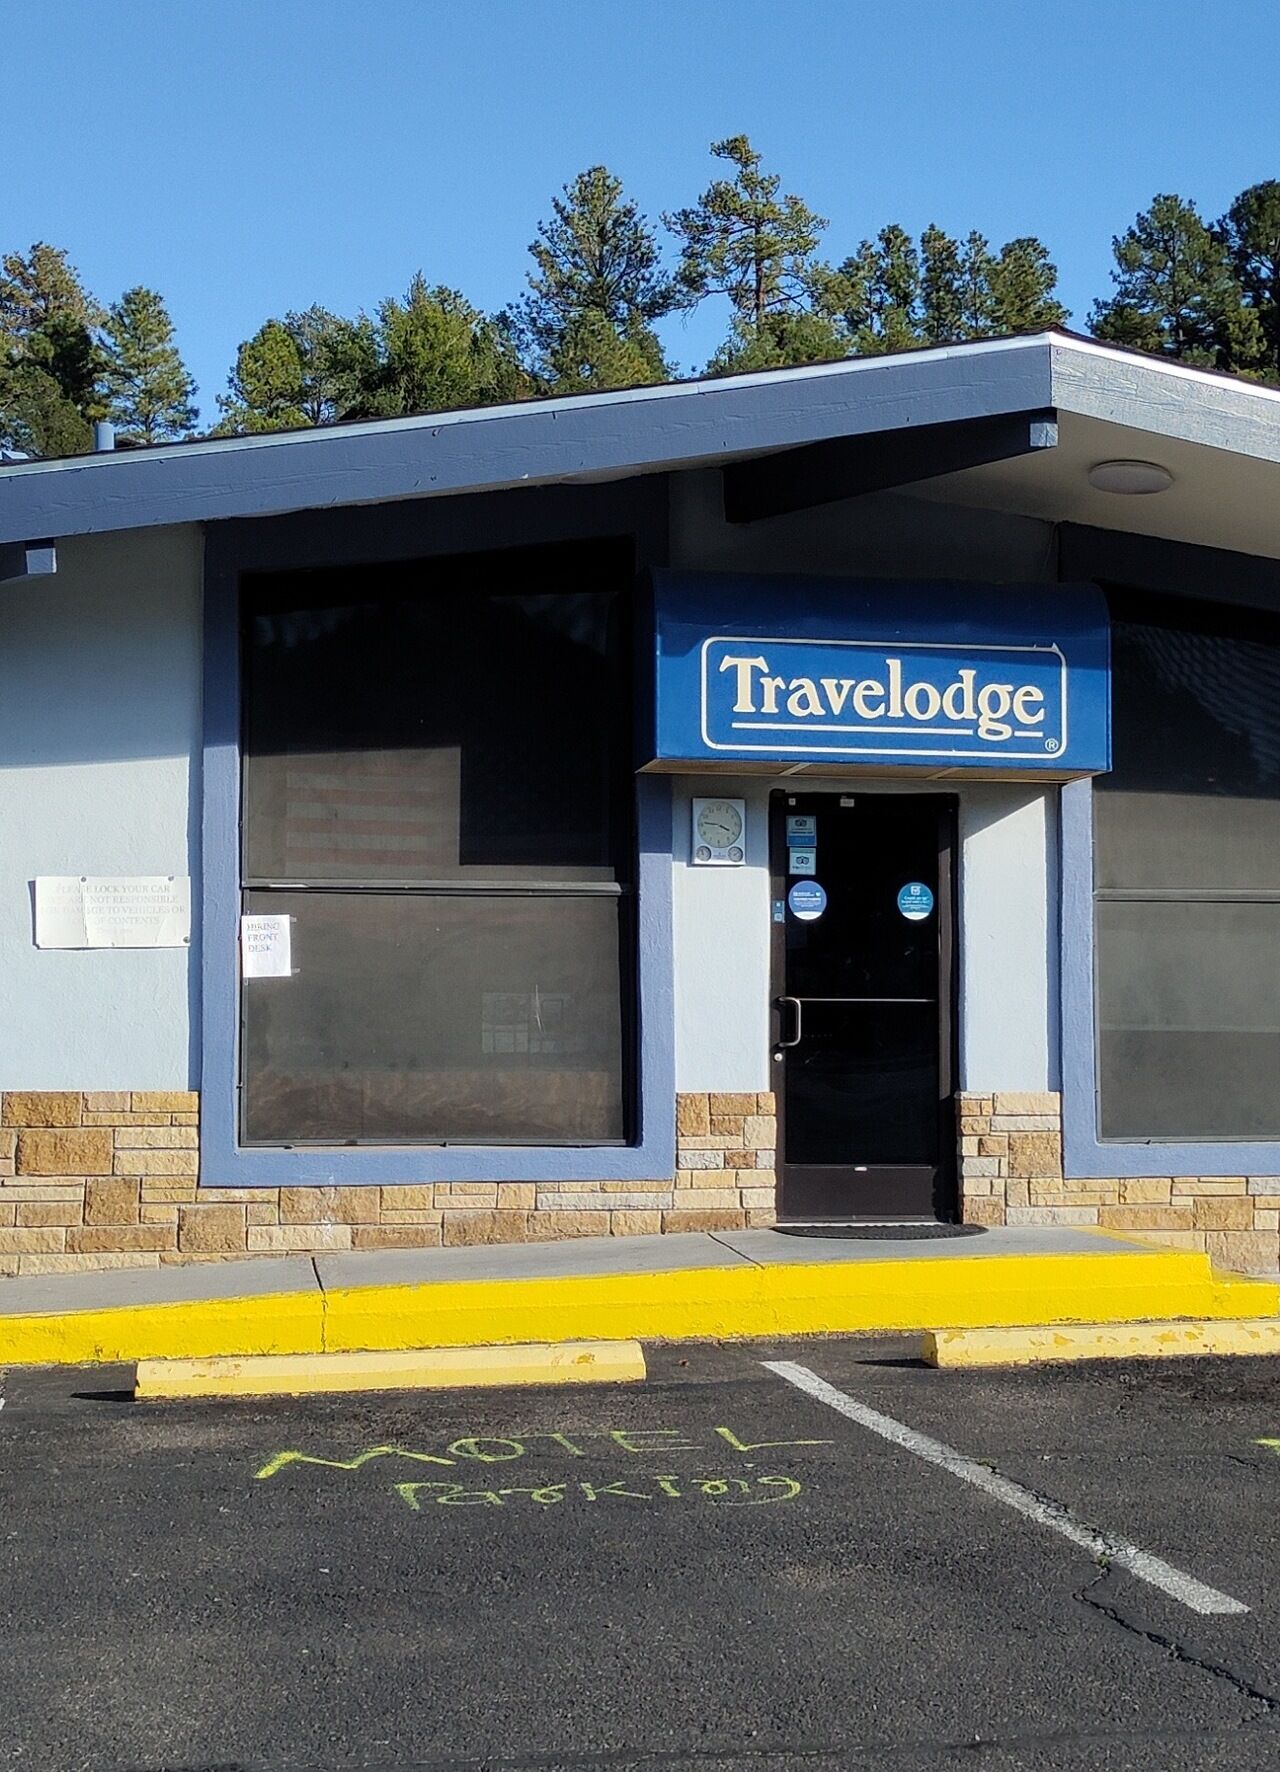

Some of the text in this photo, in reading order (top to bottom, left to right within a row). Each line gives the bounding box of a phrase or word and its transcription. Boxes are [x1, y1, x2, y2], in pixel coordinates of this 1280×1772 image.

[720, 656, 1045, 741] Travelodge
[56, 885, 171, 894] PLEAE LOCK YOUR CAR
[90, 895, 111, 904] NOT
[112, 895, 178, 904] RESPONSIBLE
[108, 906, 120, 915] TO
[120, 906, 171, 915] VEHICLES
[172, 905, 186, 914] OR
[107, 917, 160, 925] CONTENTS
[248, 922, 280, 931] HIRING
[248, 933, 279, 942] FRONT
[248, 944, 273, 953] DESK
[252, 1427, 834, 1479] MOTEL
